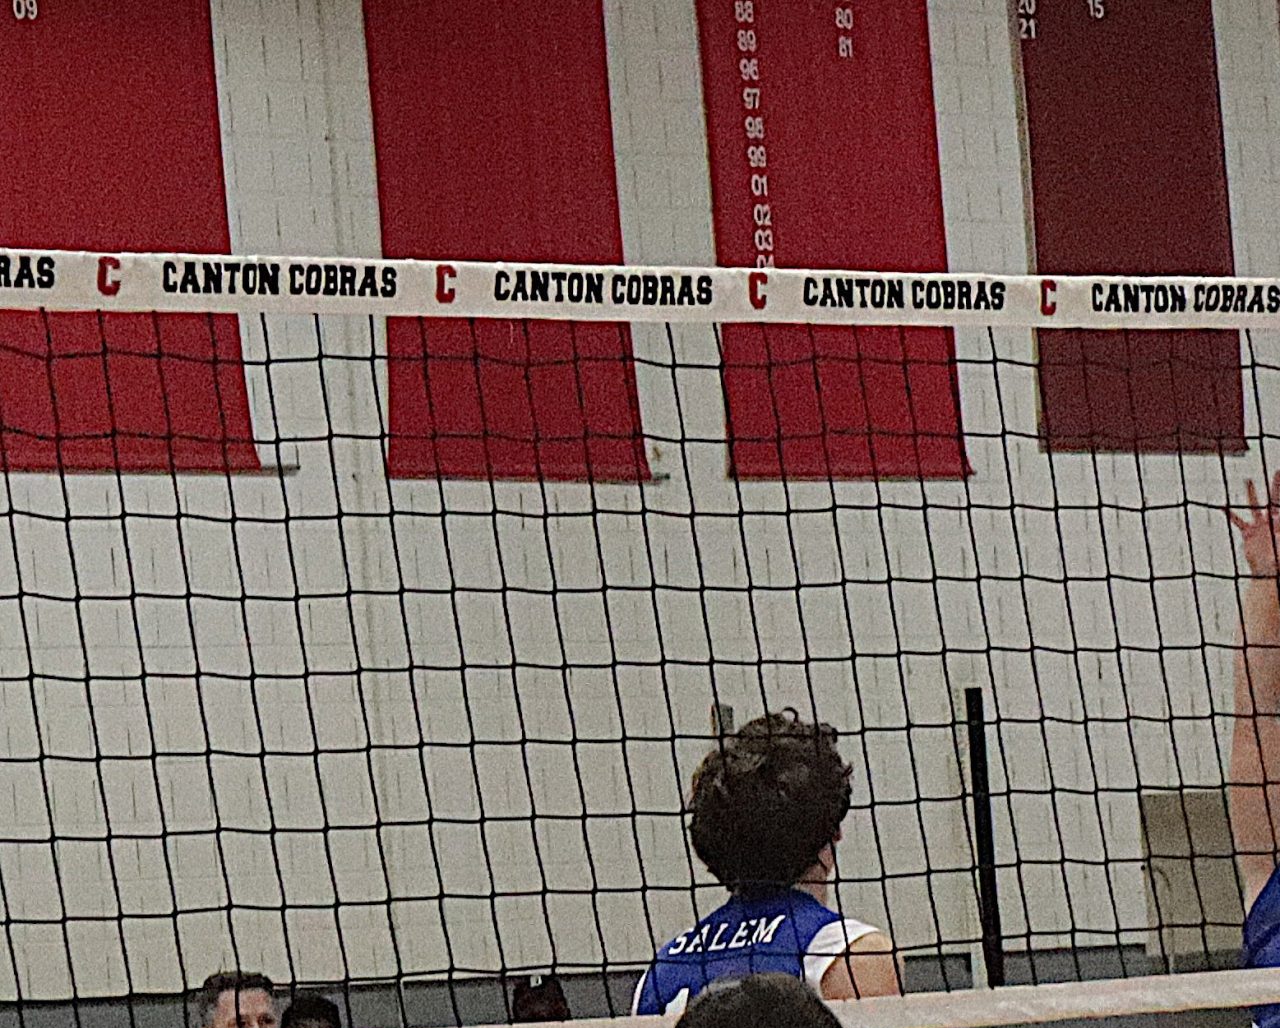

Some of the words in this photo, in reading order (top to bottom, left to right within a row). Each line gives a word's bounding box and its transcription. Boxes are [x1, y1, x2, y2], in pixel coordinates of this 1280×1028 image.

[13, 0, 38, 20] 09
[734, 1, 754, 23] 88
[835, 7, 853, 30] 80
[1087, 0, 1104, 19] 15
[737, 29, 756, 51] 89
[1019, 18, 1036, 39] 21
[739, 58, 759, 80] 96
[743, 87, 760, 109] 97
[744, 116, 765, 139] 98
[747, 145, 767, 168] 99
[751, 173, 768, 196] 01
[753, 203, 772, 226] 02
[754, 228, 773, 251] 03
[97, 256, 121, 296] C
[162, 261, 281, 295] CANTON
[288, 264, 397, 298] COBRAS
[435, 264, 457, 304] C
[494, 270, 605, 304] CANTON
[611, 274, 713, 306] COBRAS
[748, 271, 768, 310] C
[803, 277, 905, 309] CANTON
[911, 280, 1006, 310] COBRAS
[1040, 279, 1057, 315] C
[1091, 283, 1187, 313] CANTON
[1193, 285, 1280, 314] COBRAS
[668, 914, 788, 956] SALEM
